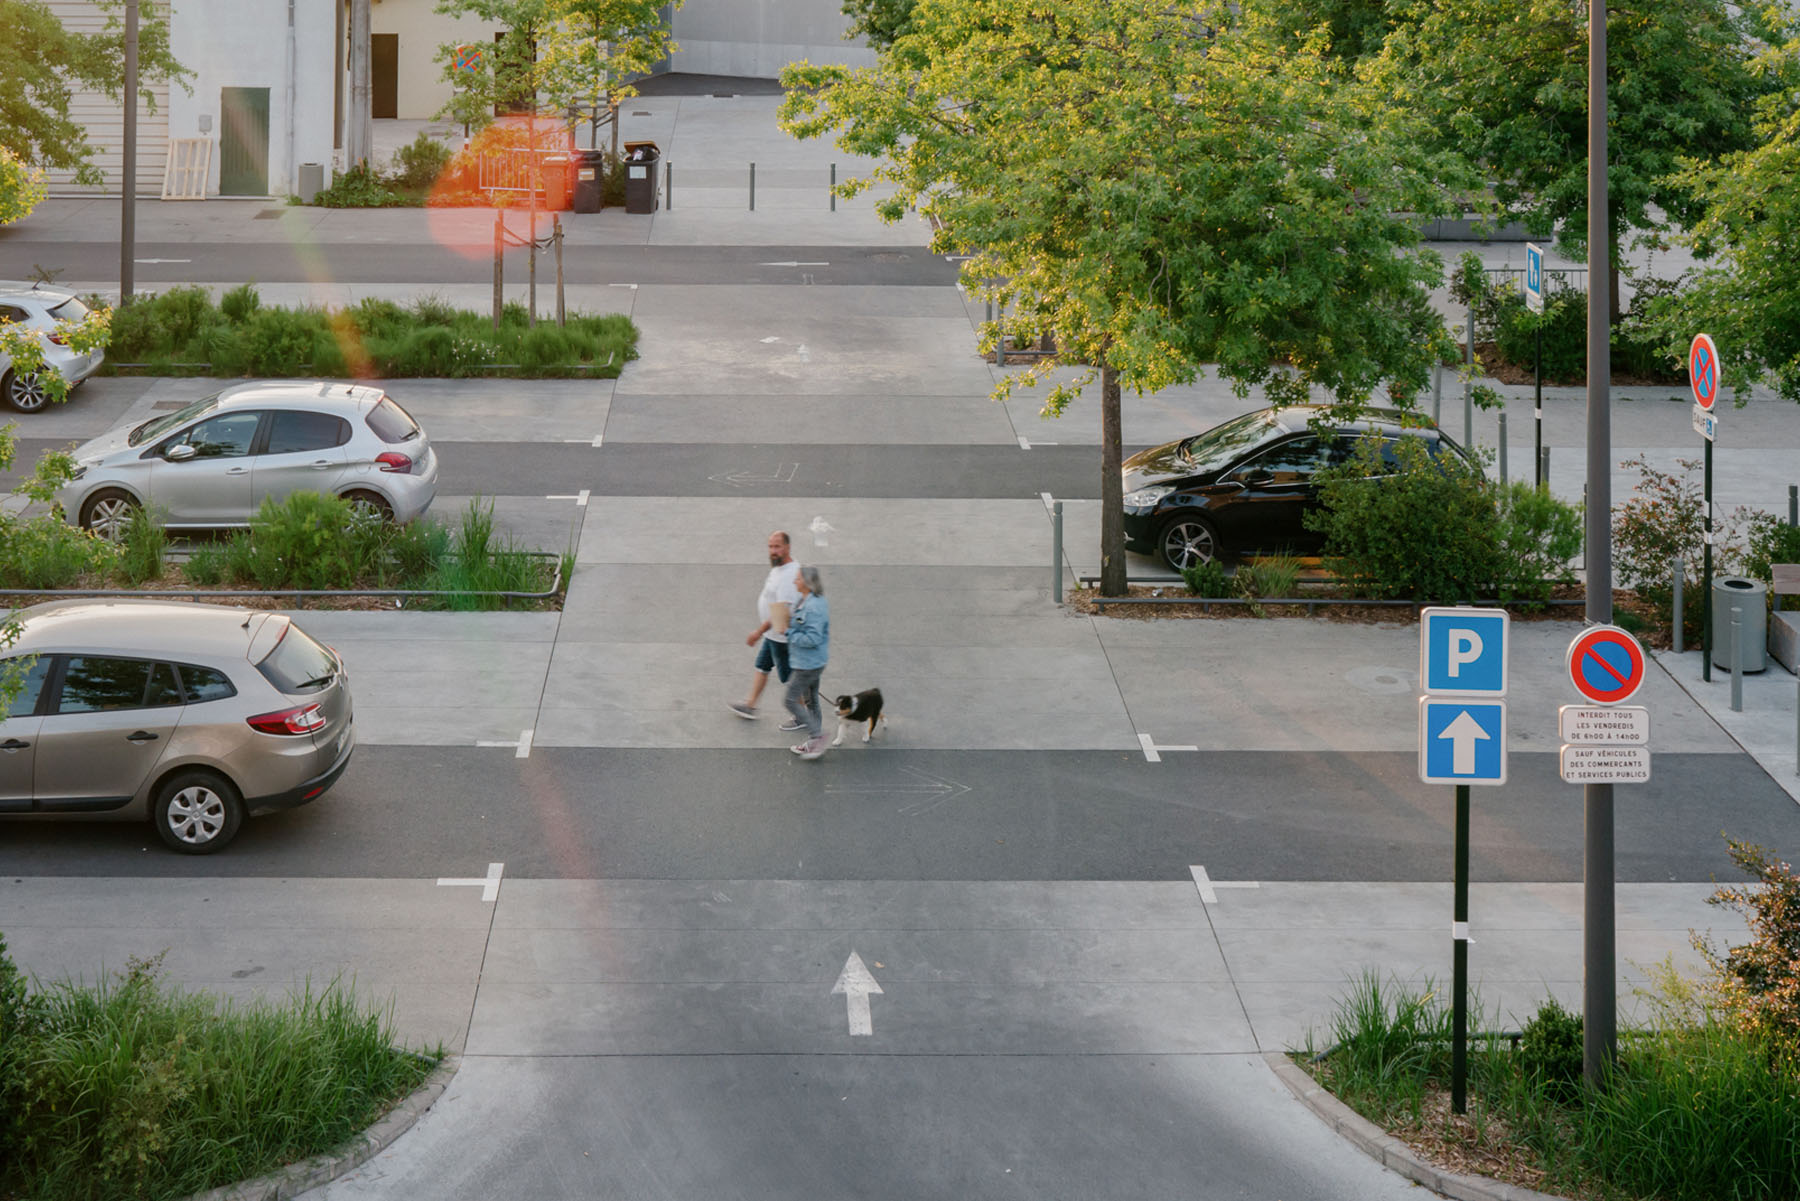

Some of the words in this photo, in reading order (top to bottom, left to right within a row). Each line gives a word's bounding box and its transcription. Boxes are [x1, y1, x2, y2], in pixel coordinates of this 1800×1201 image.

[1448, 628, 1484, 678] P
[1575, 750, 1594, 758] SAUF
[1597, 749, 1637, 757] VÉHICULES
